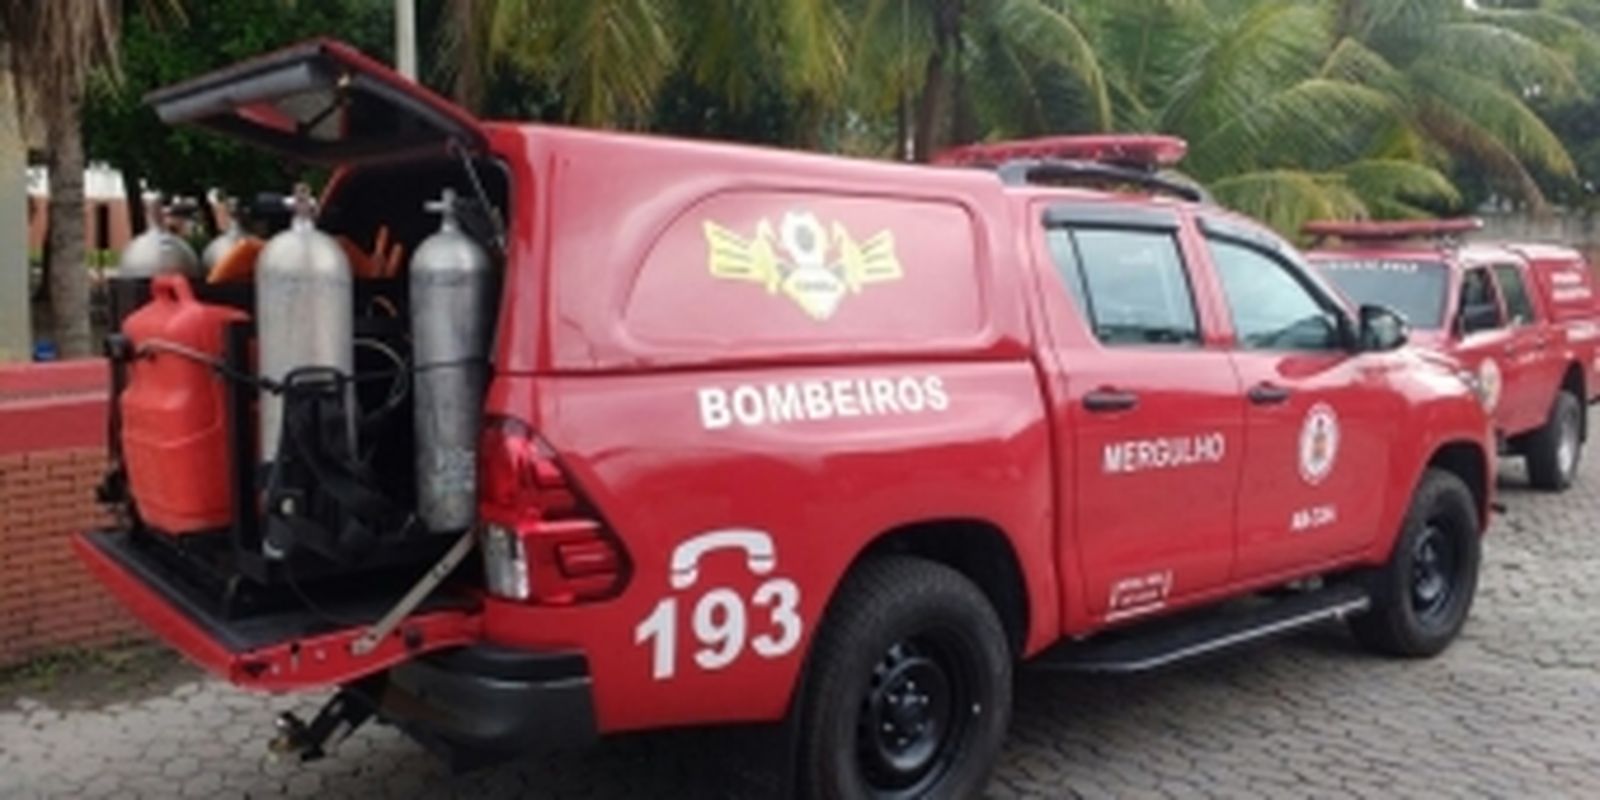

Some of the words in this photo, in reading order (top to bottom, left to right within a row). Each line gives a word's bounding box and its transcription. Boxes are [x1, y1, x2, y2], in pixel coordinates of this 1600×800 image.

[698, 375, 950, 429] BOMBEIROS
[1103, 432, 1225, 473] MERGULHO
[635, 577, 802, 680] 193
